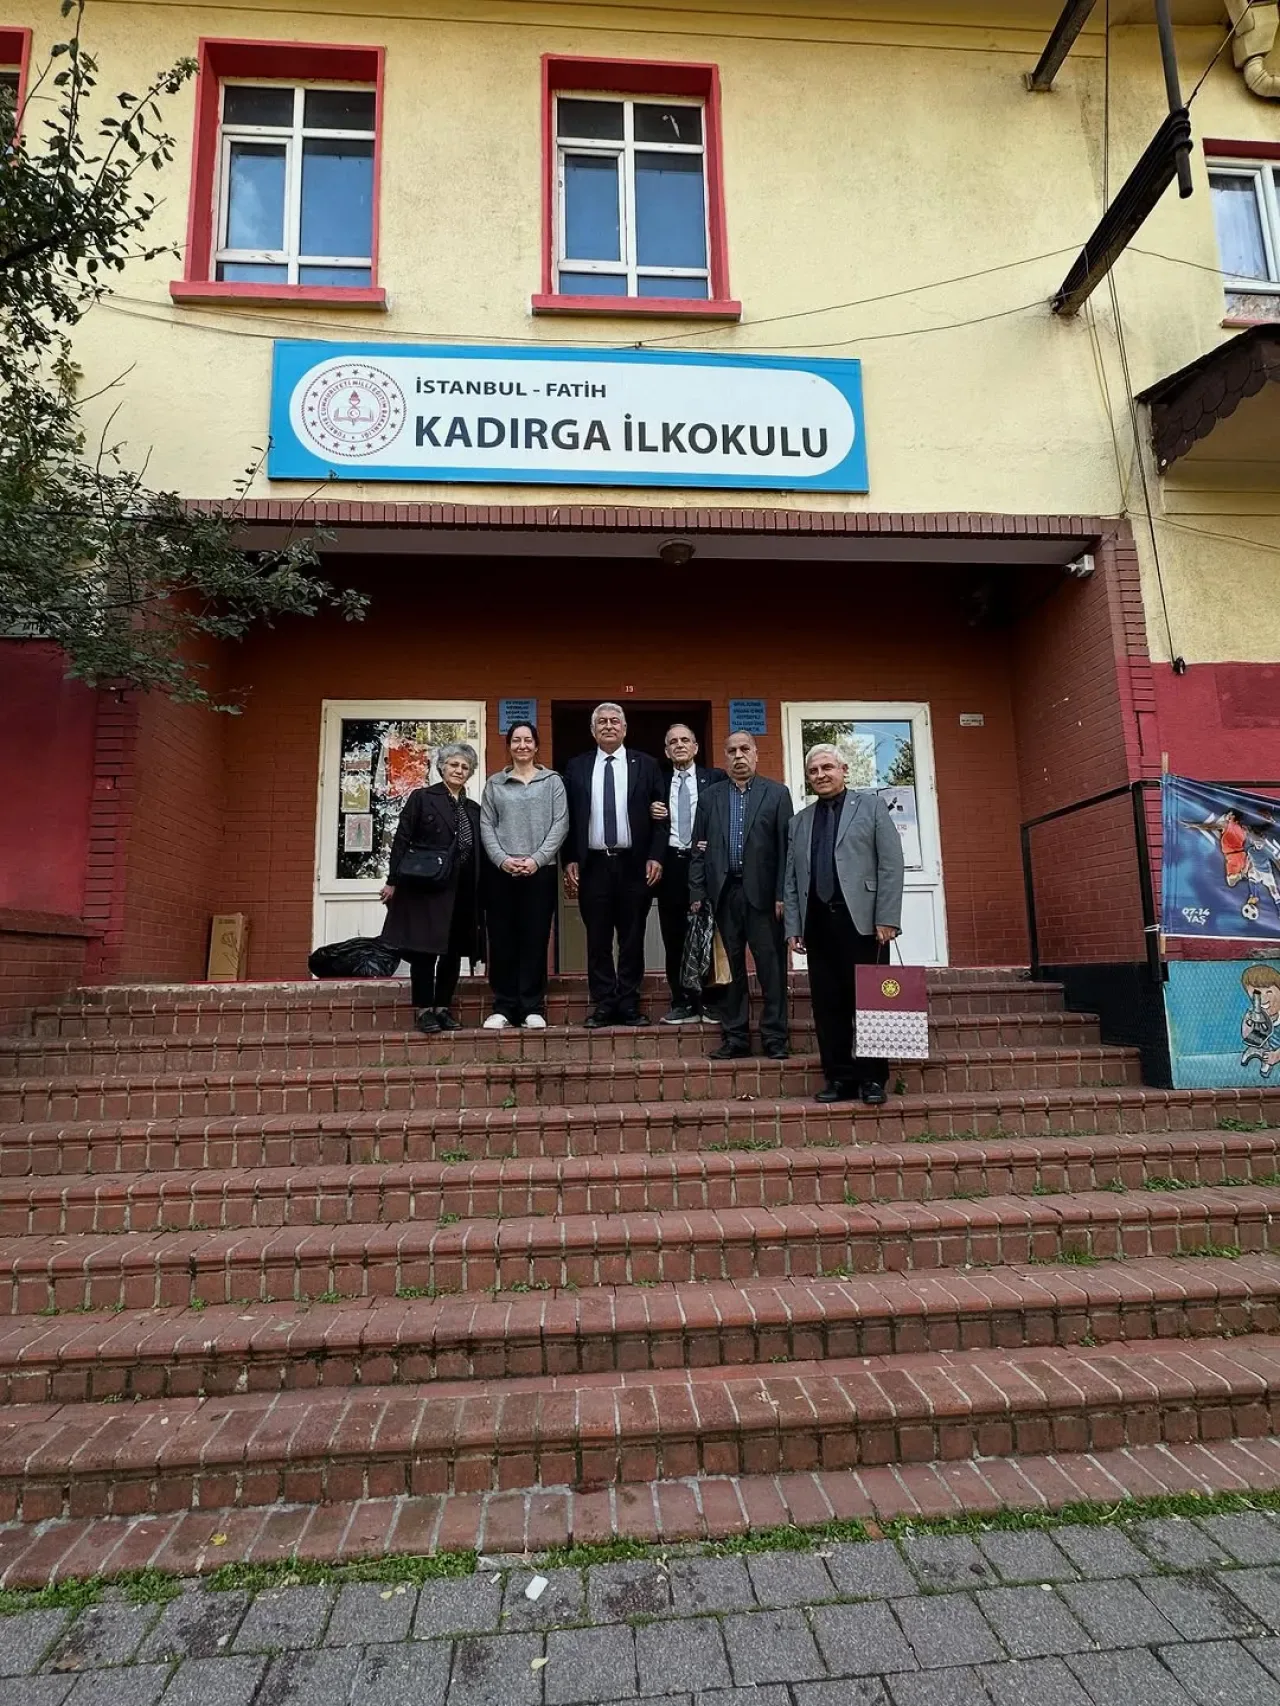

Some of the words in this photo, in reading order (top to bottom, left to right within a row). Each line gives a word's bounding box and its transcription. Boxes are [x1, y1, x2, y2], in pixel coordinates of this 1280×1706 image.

[416, 377, 527, 396] İSTANBUL
[546, 381, 606, 398] FATİH
[415, 416, 611, 451] KADIRGA
[624, 413, 828, 458] İLKOKULU
